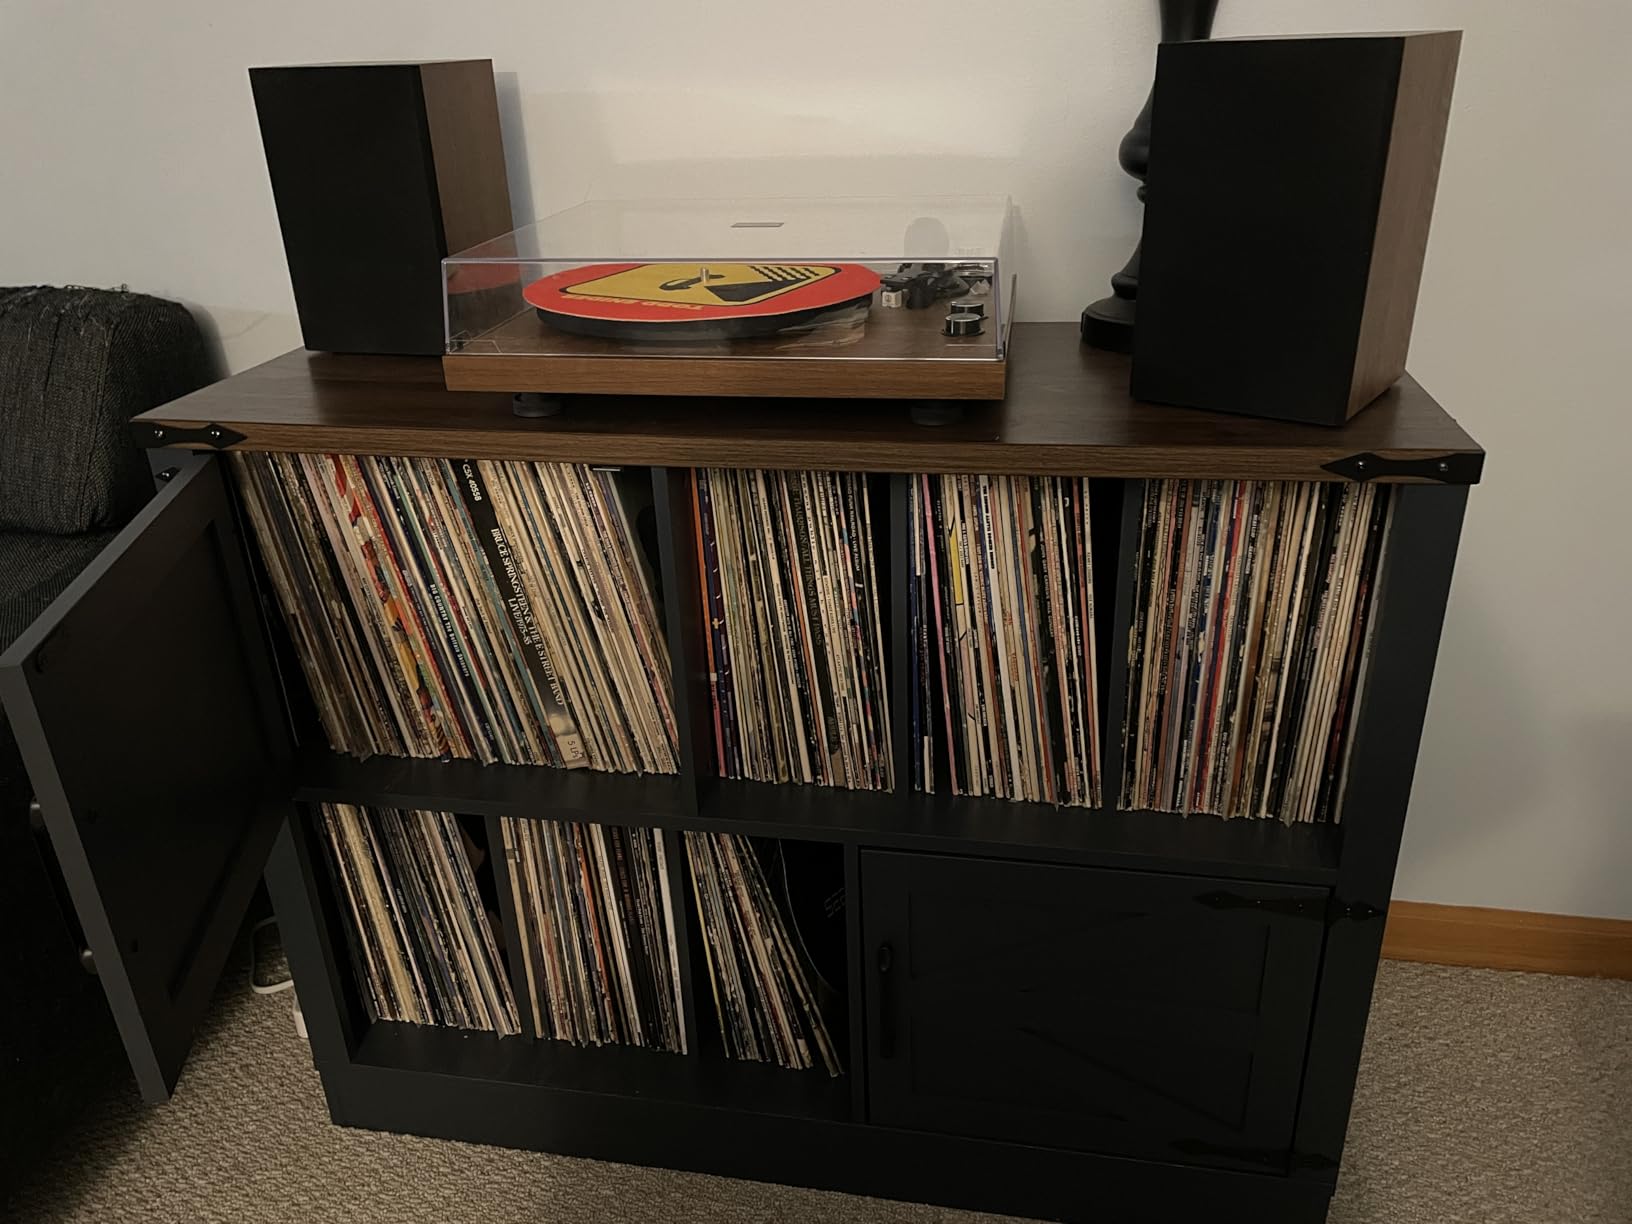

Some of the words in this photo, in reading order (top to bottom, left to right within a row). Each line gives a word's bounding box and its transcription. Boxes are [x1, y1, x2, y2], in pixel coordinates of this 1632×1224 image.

[467, 477, 482, 502] 40558
[429, 582, 438, 595] BIG
[433, 595, 449, 622] COUNTRY
[490, 526, 509, 558] BRUCE
[501, 556, 530, 615] SPRINGSTEEN
[527, 624, 542, 644] THE
[536, 648, 557, 682] STREET
